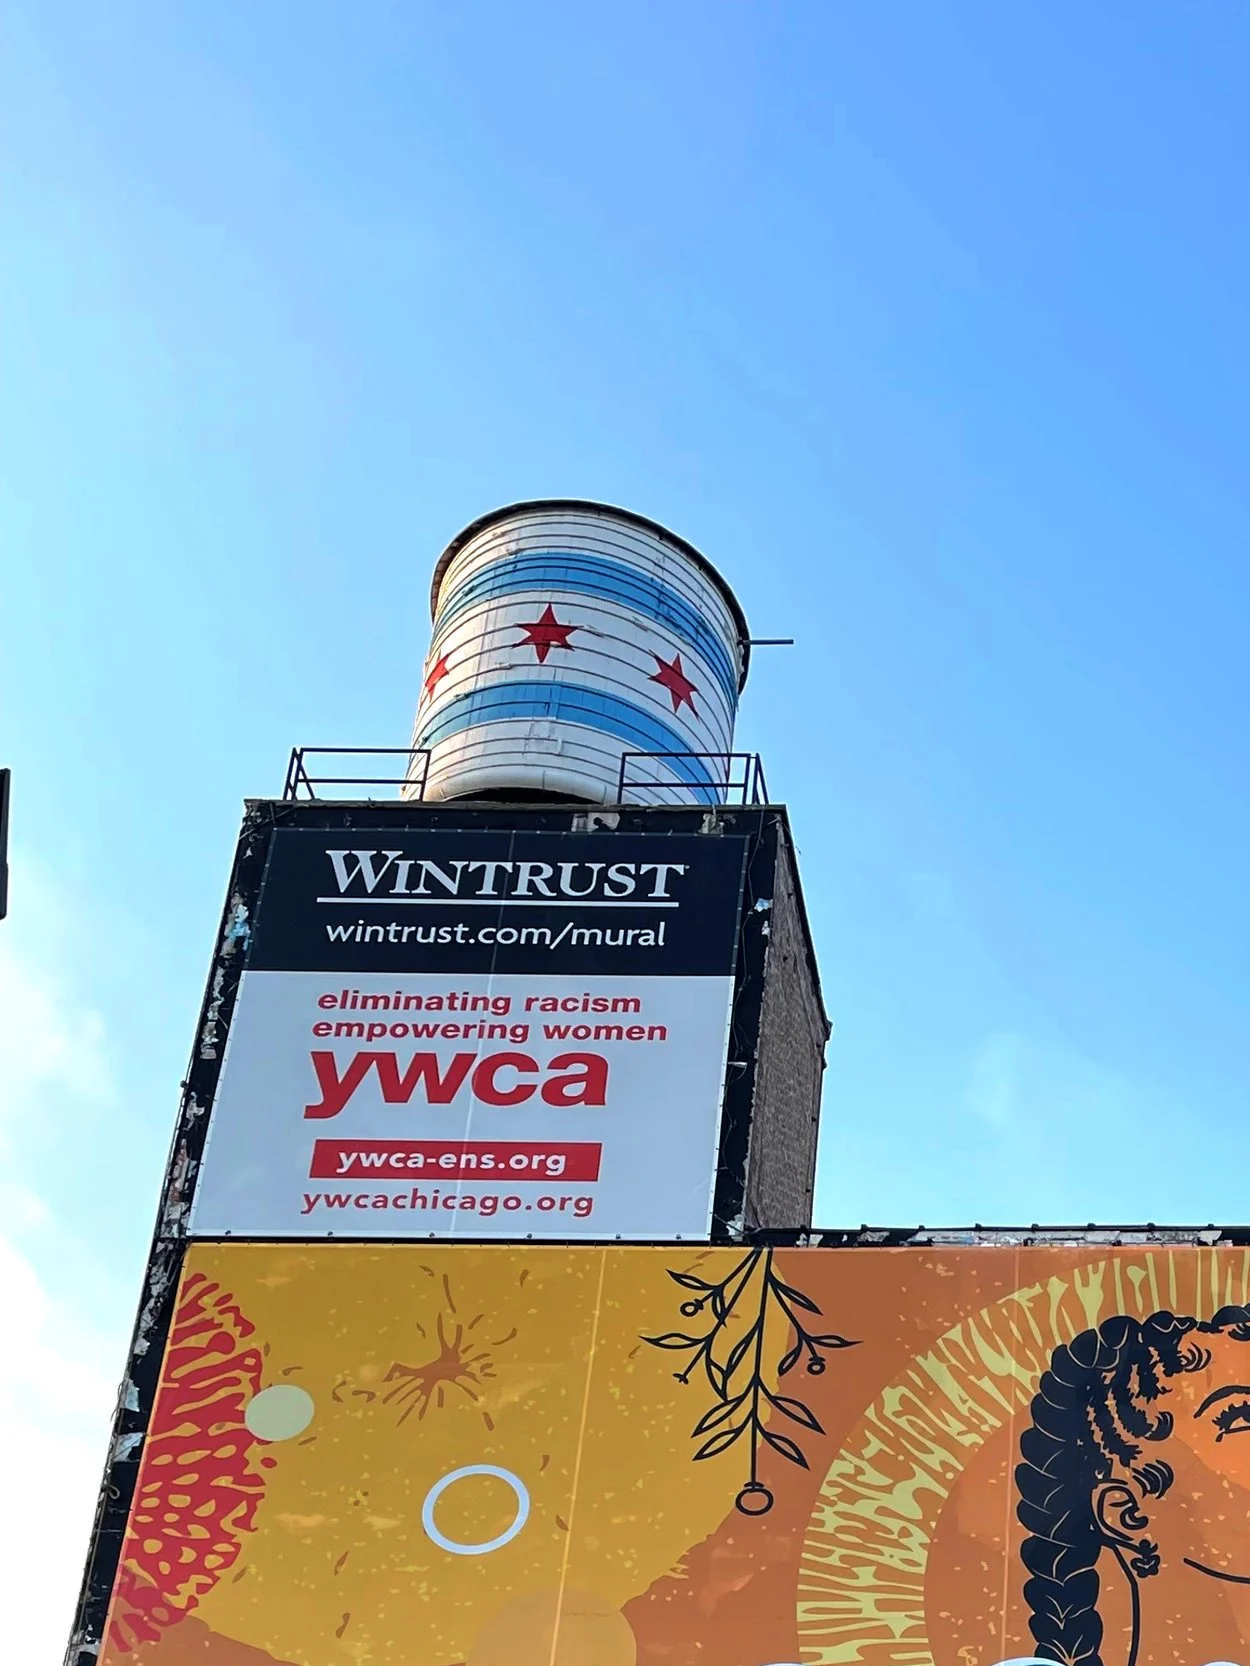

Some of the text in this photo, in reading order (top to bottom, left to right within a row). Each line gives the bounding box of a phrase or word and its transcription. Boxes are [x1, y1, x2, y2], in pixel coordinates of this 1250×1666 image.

[325, 849, 686, 898] WINTRUST
[325, 920, 666, 950] wintrust.com/mural
[316, 990, 642, 1016] eliminating racism
[312, 1019, 668, 1043] empowering women
[303, 1050, 610, 1119] ywca
[335, 1148, 566, 1175] ywca-ens.org
[300, 1188, 594, 1217] ywcachicago.org
